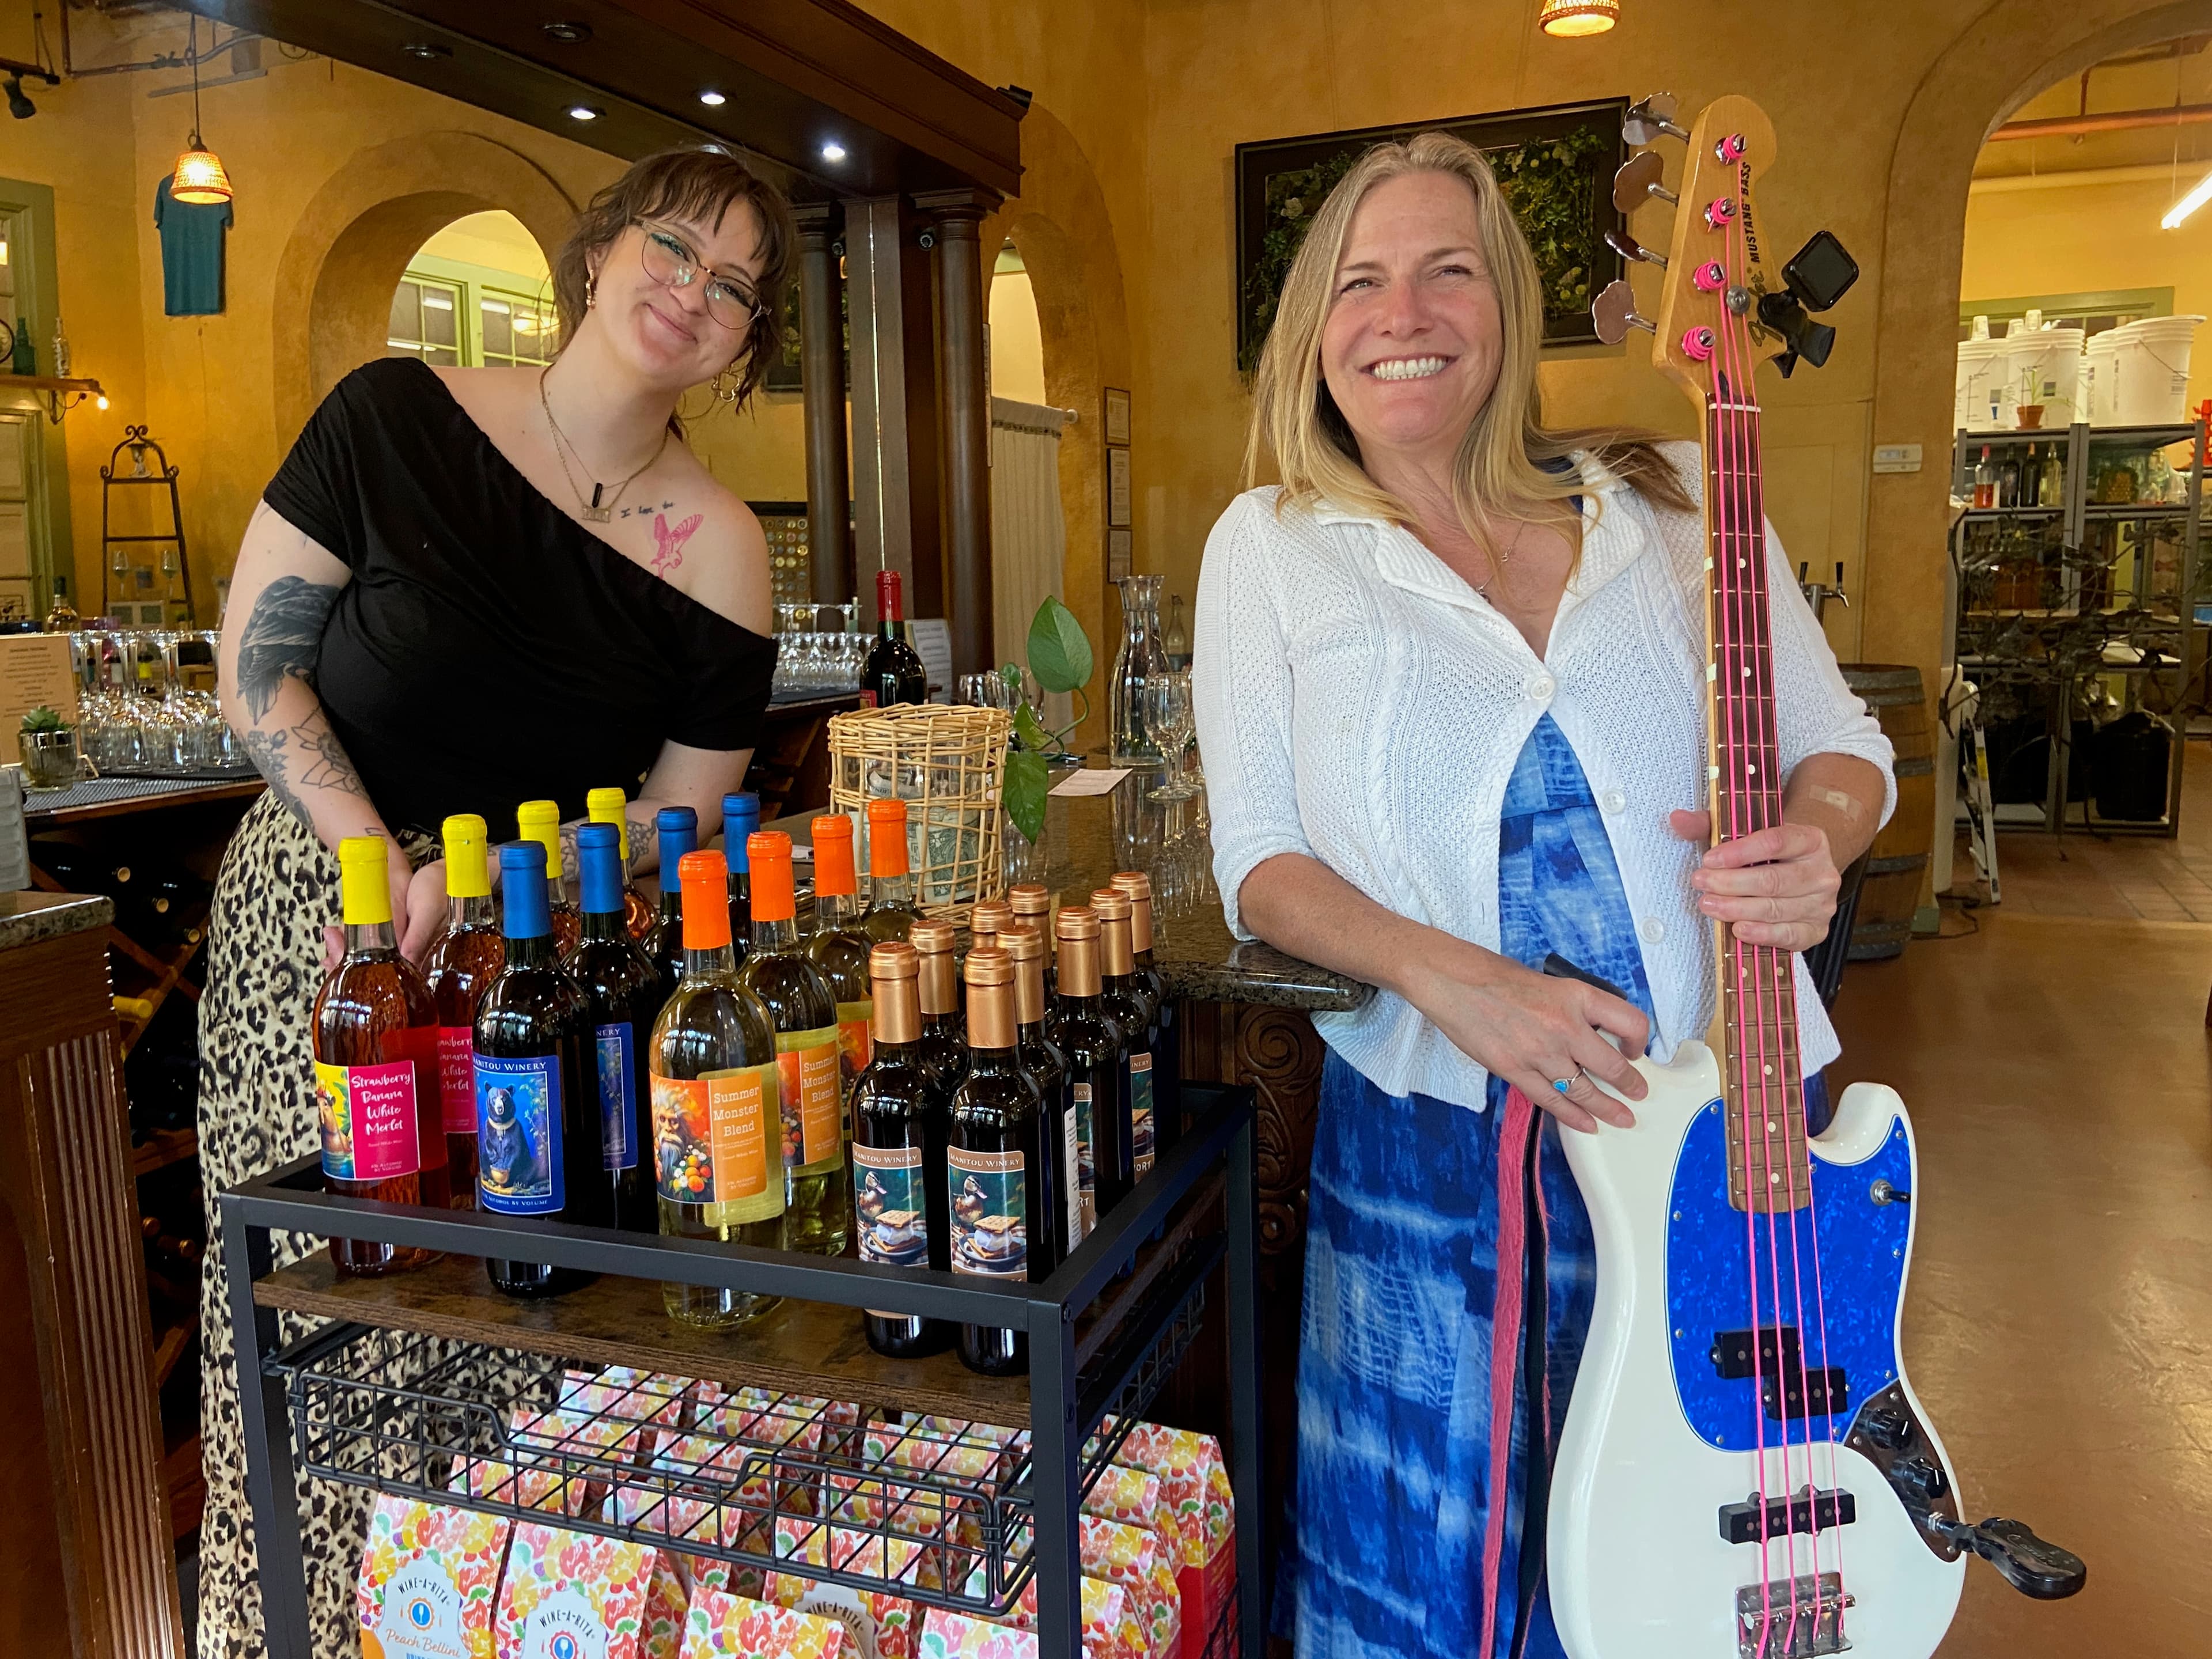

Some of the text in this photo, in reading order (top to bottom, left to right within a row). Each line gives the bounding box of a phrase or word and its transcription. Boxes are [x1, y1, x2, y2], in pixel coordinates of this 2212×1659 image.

[1740, 162, 1760, 263] MUSTANG BASS
[596, 1028, 621, 1036] NERY
[440, 1053, 469, 1061] anana
[1131, 1059, 1149, 1067] INERY
[504, 1062, 546, 1071] WINERY
[351, 1073, 411, 1088] Strawberry
[803, 1070, 835, 1088] Monster
[361, 1090, 403, 1104] Banana
[714, 1086, 759, 1104] Summer
[812, 1085, 834, 1102] Blend
[366, 1104, 402, 1119] White
[713, 1104, 759, 1121] Monster
[365, 1119, 403, 1136] Merlot
[724, 1119, 755, 1137] Blend
[884, 1154, 917, 1164] WINERY
[950, 1153, 1020, 1167] MANITOU WINERY
[1079, 1196, 1089, 1207] RT
[397, 1577, 448, 1604] WINE-A-RITA
[539, 1609, 593, 1638] WINE-A-RITA
[385, 1628, 461, 1658] Peach Bellini
